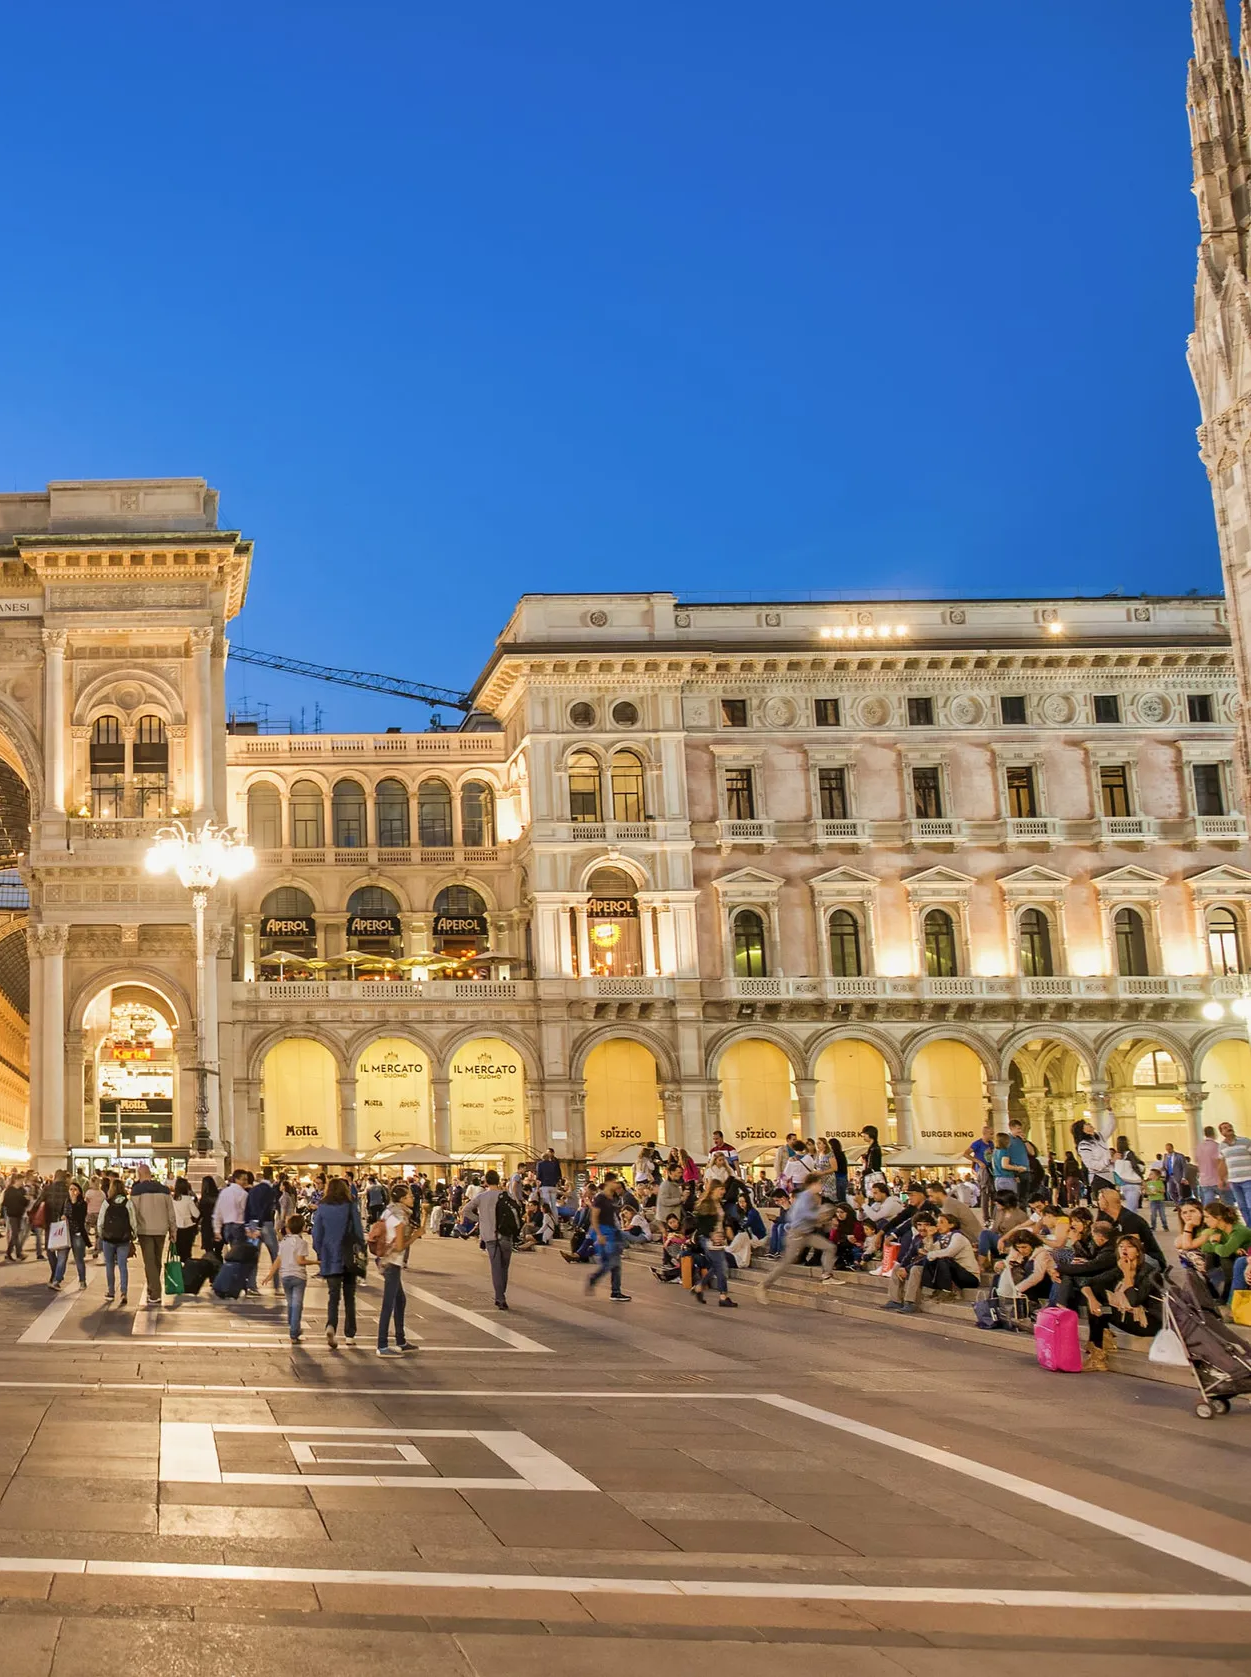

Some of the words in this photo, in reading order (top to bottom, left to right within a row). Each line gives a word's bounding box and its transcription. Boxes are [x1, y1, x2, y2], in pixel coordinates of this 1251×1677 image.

[587, 898, 633, 912] APEROL
[266, 919, 309, 931] APEROL
[351, 918, 395, 930] APEROL
[437, 917, 481, 930] APEROL
[360, 1064, 368, 1072] IL
[371, 1064, 423, 1073] MERCATO
[453, 1065, 463, 1073] IL
[465, 1065, 517, 1074] MERCATO
[286, 1125, 319, 1136] Motta
[600, 1126, 642, 1139] spizzico
[735, 1126, 777, 1140] spizzico
